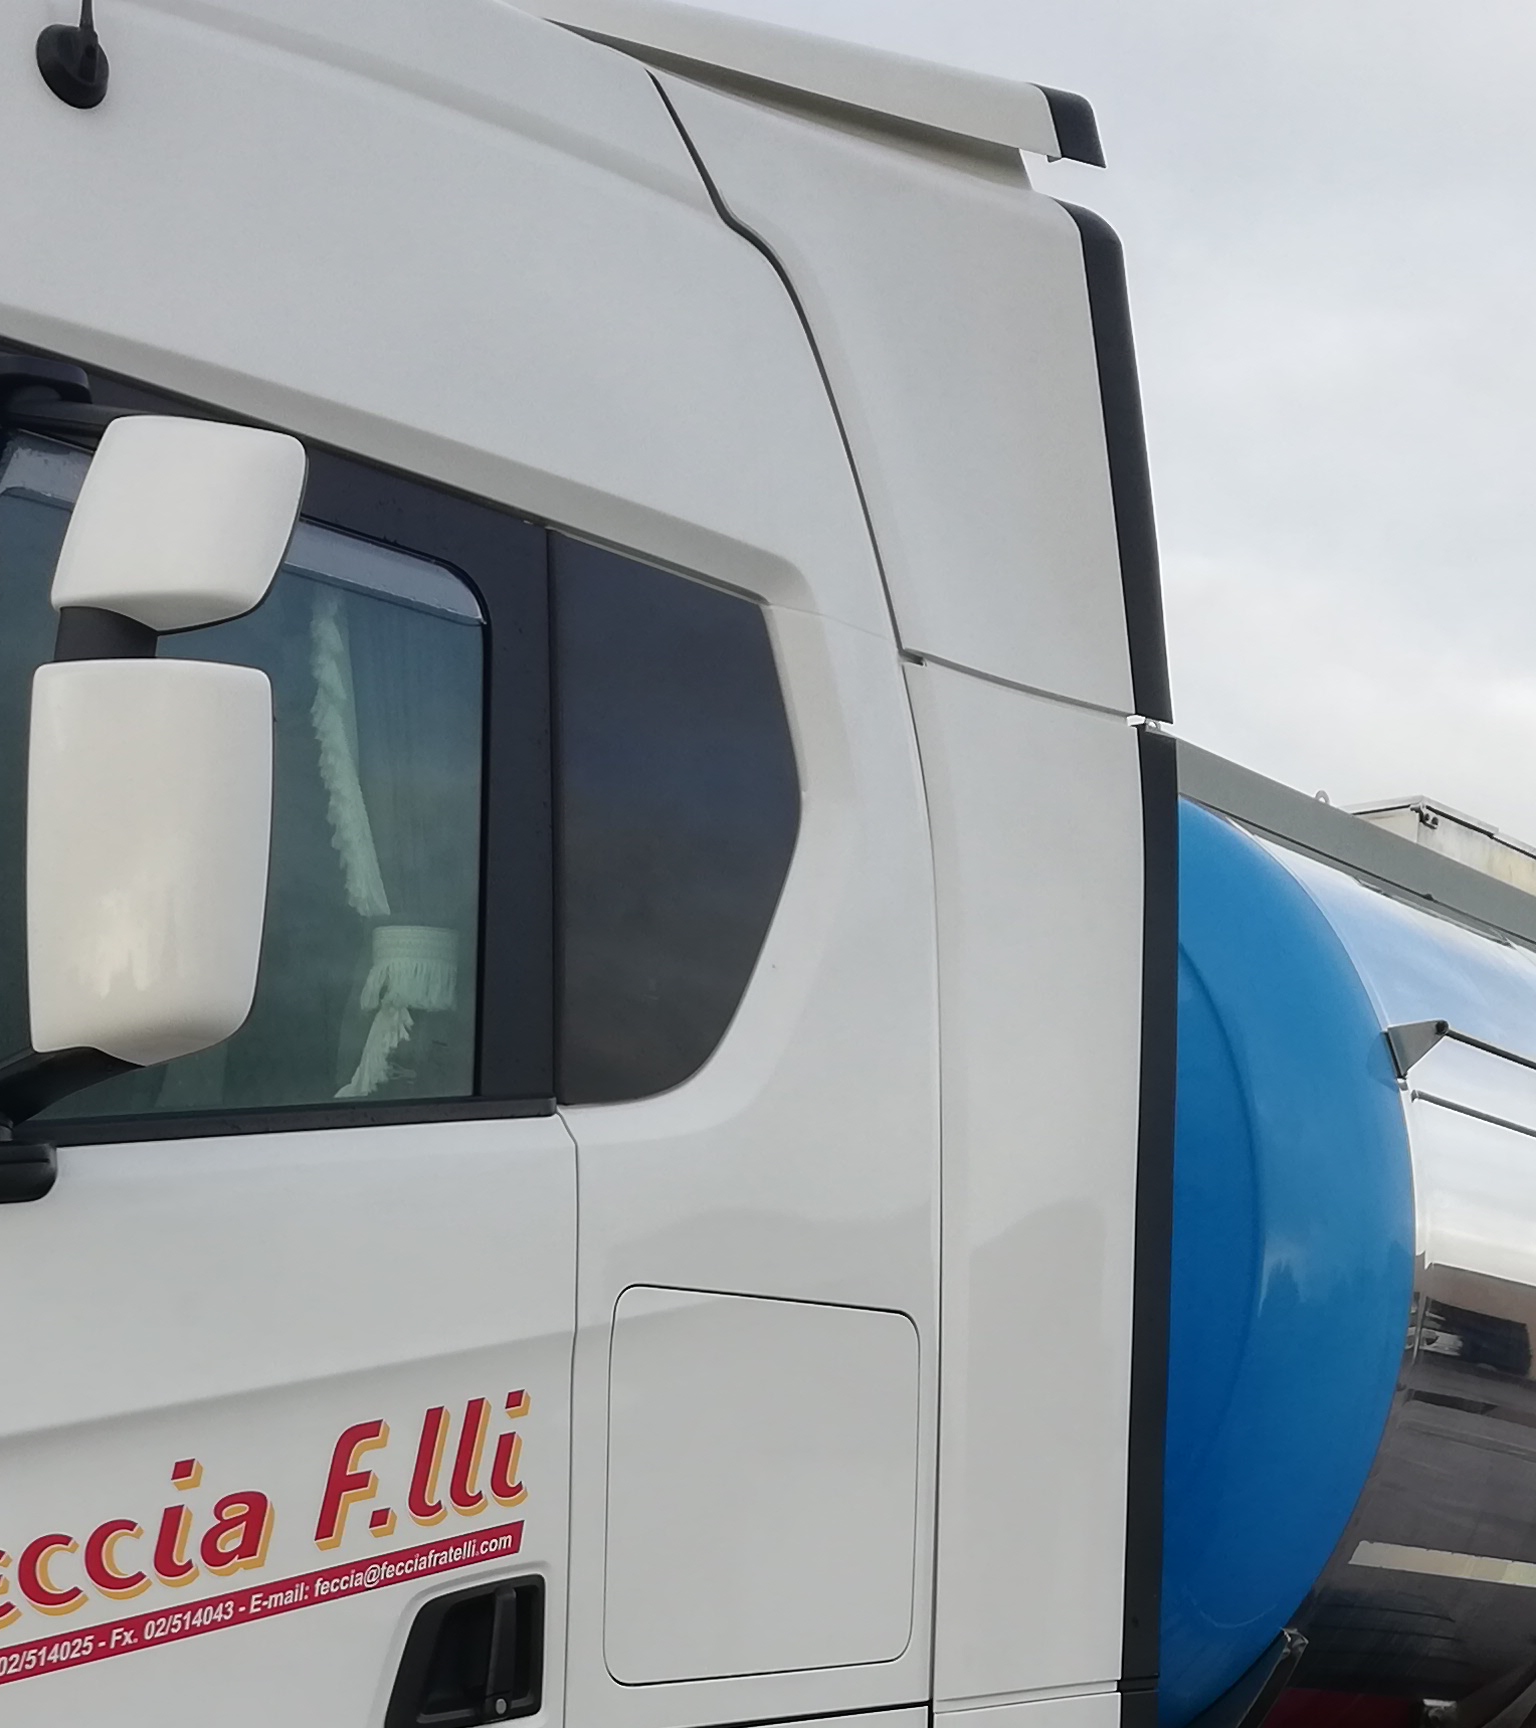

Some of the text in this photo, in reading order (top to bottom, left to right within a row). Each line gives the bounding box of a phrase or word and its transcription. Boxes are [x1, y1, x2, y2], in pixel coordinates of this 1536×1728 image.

[314, 1389, 531, 1552] F.lli
[109, 1627, 139, 1650] Fx.
[143, 1602, 235, 1641] 02/514043
[249, 1583, 310, 1615] E-mail:
[313, 1531, 513, 1598] feccia@fecciafratelli.com
